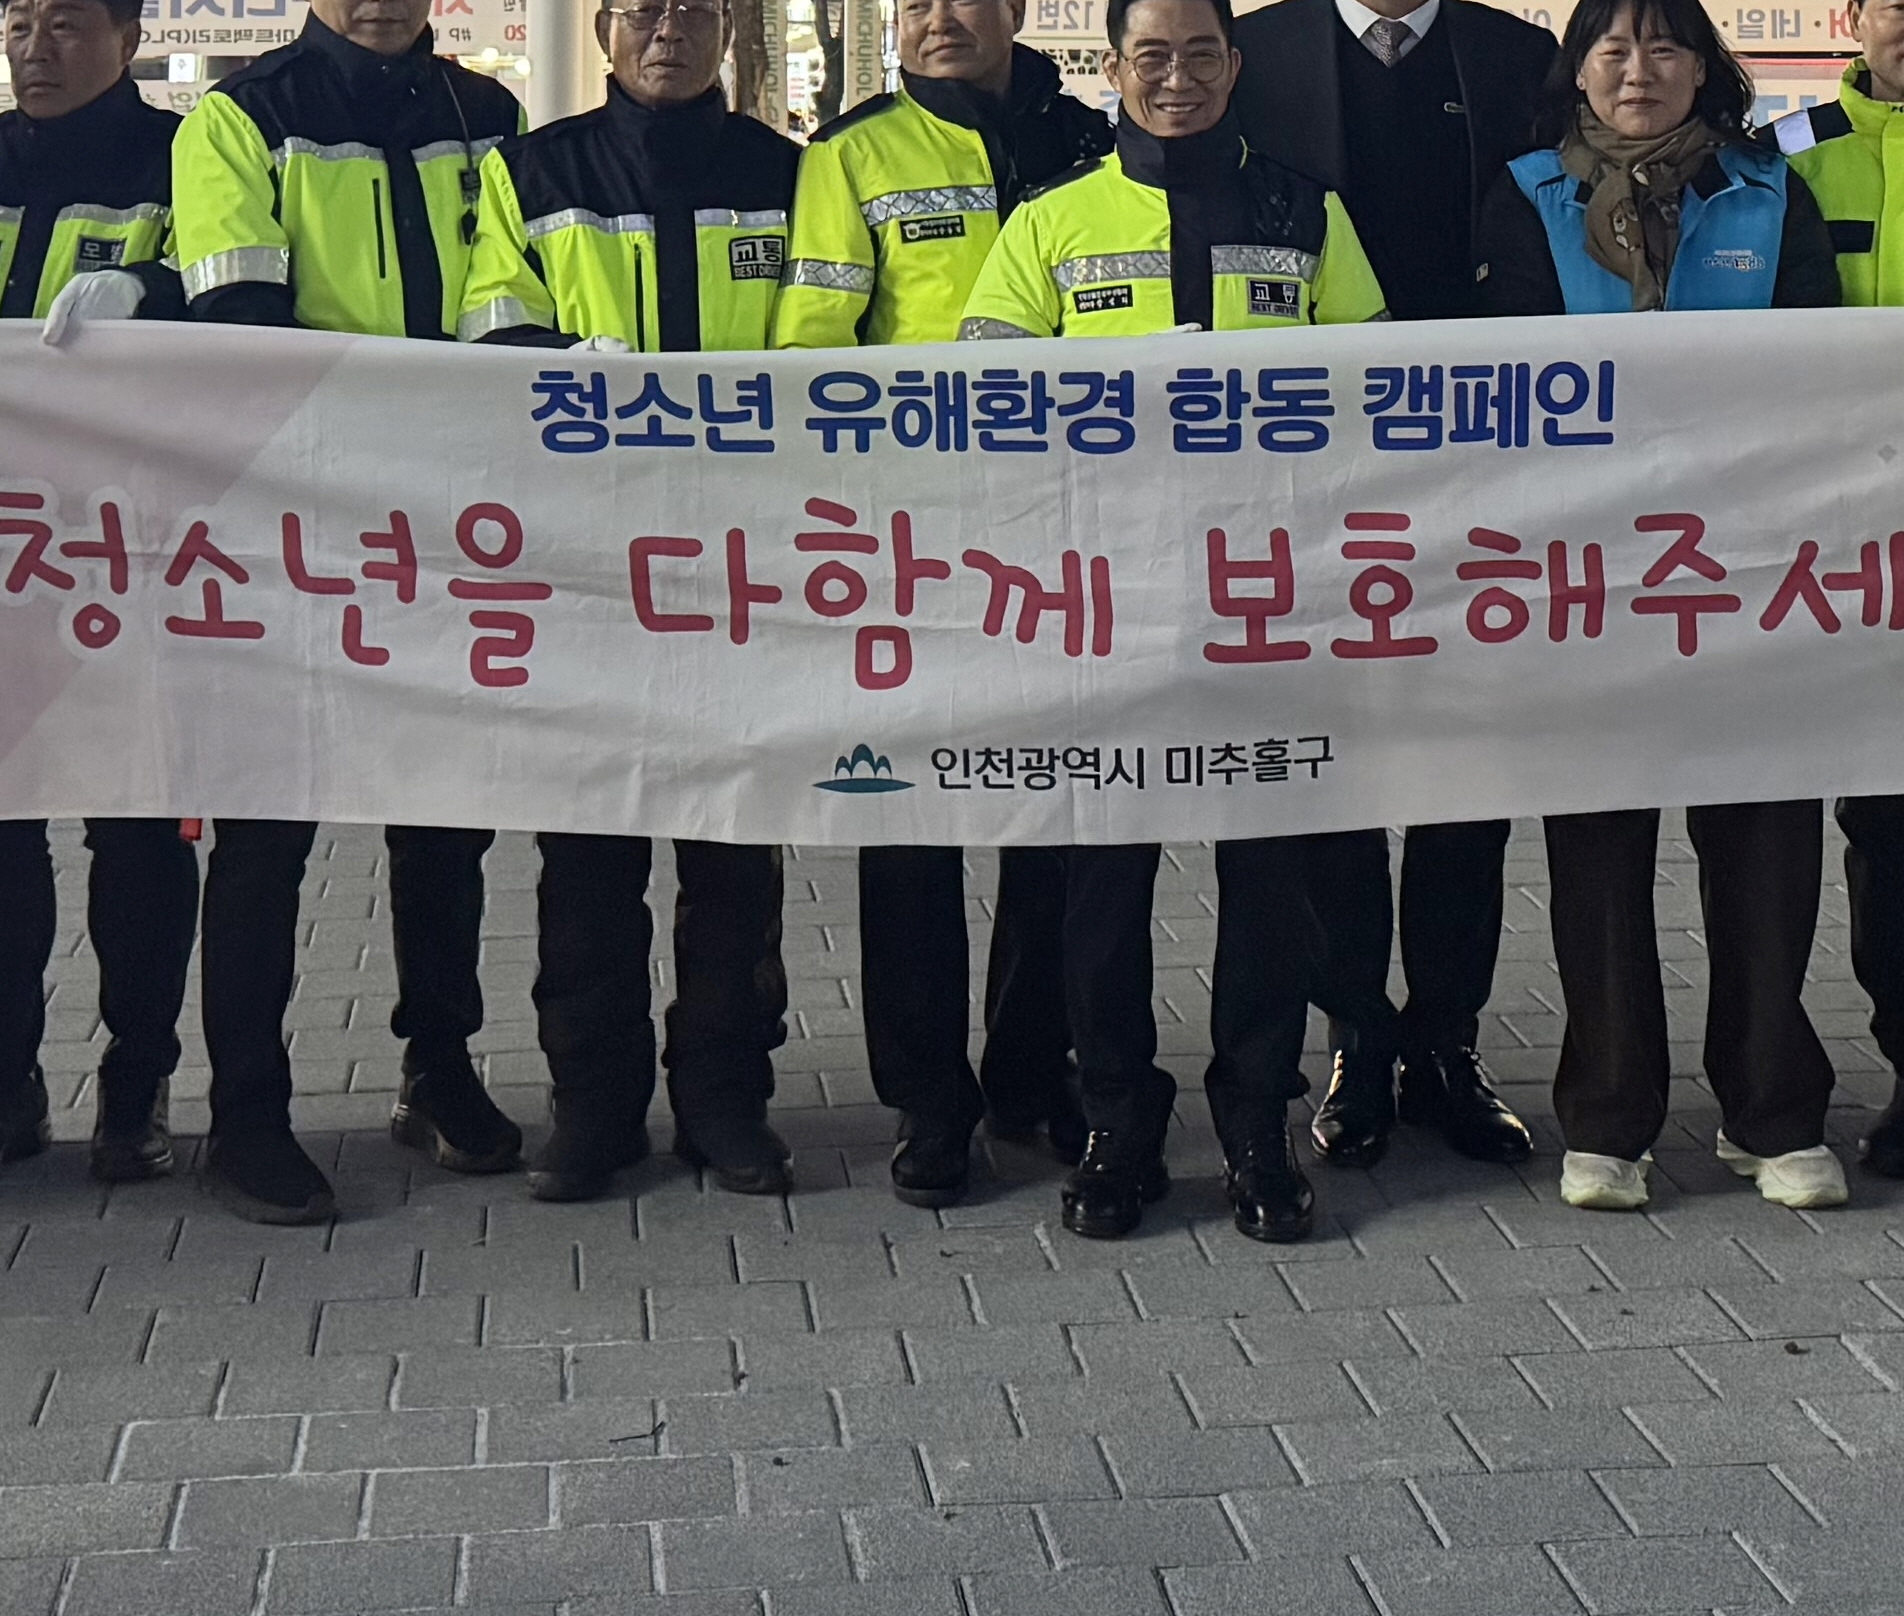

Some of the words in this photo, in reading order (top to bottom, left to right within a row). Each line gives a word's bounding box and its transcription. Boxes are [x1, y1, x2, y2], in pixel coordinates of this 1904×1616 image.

[530, 368, 777, 455] 청소년
[804, 366, 1138, 455] 유해환경
[1165, 363, 1335, 454] 합동
[1361, 359, 1616, 452] 캠페인
[628, 496, 1114, 692] 다함께
[929, 746, 1147, 791] 인천광역시
[1164, 735, 1336, 788] 미추홀구
